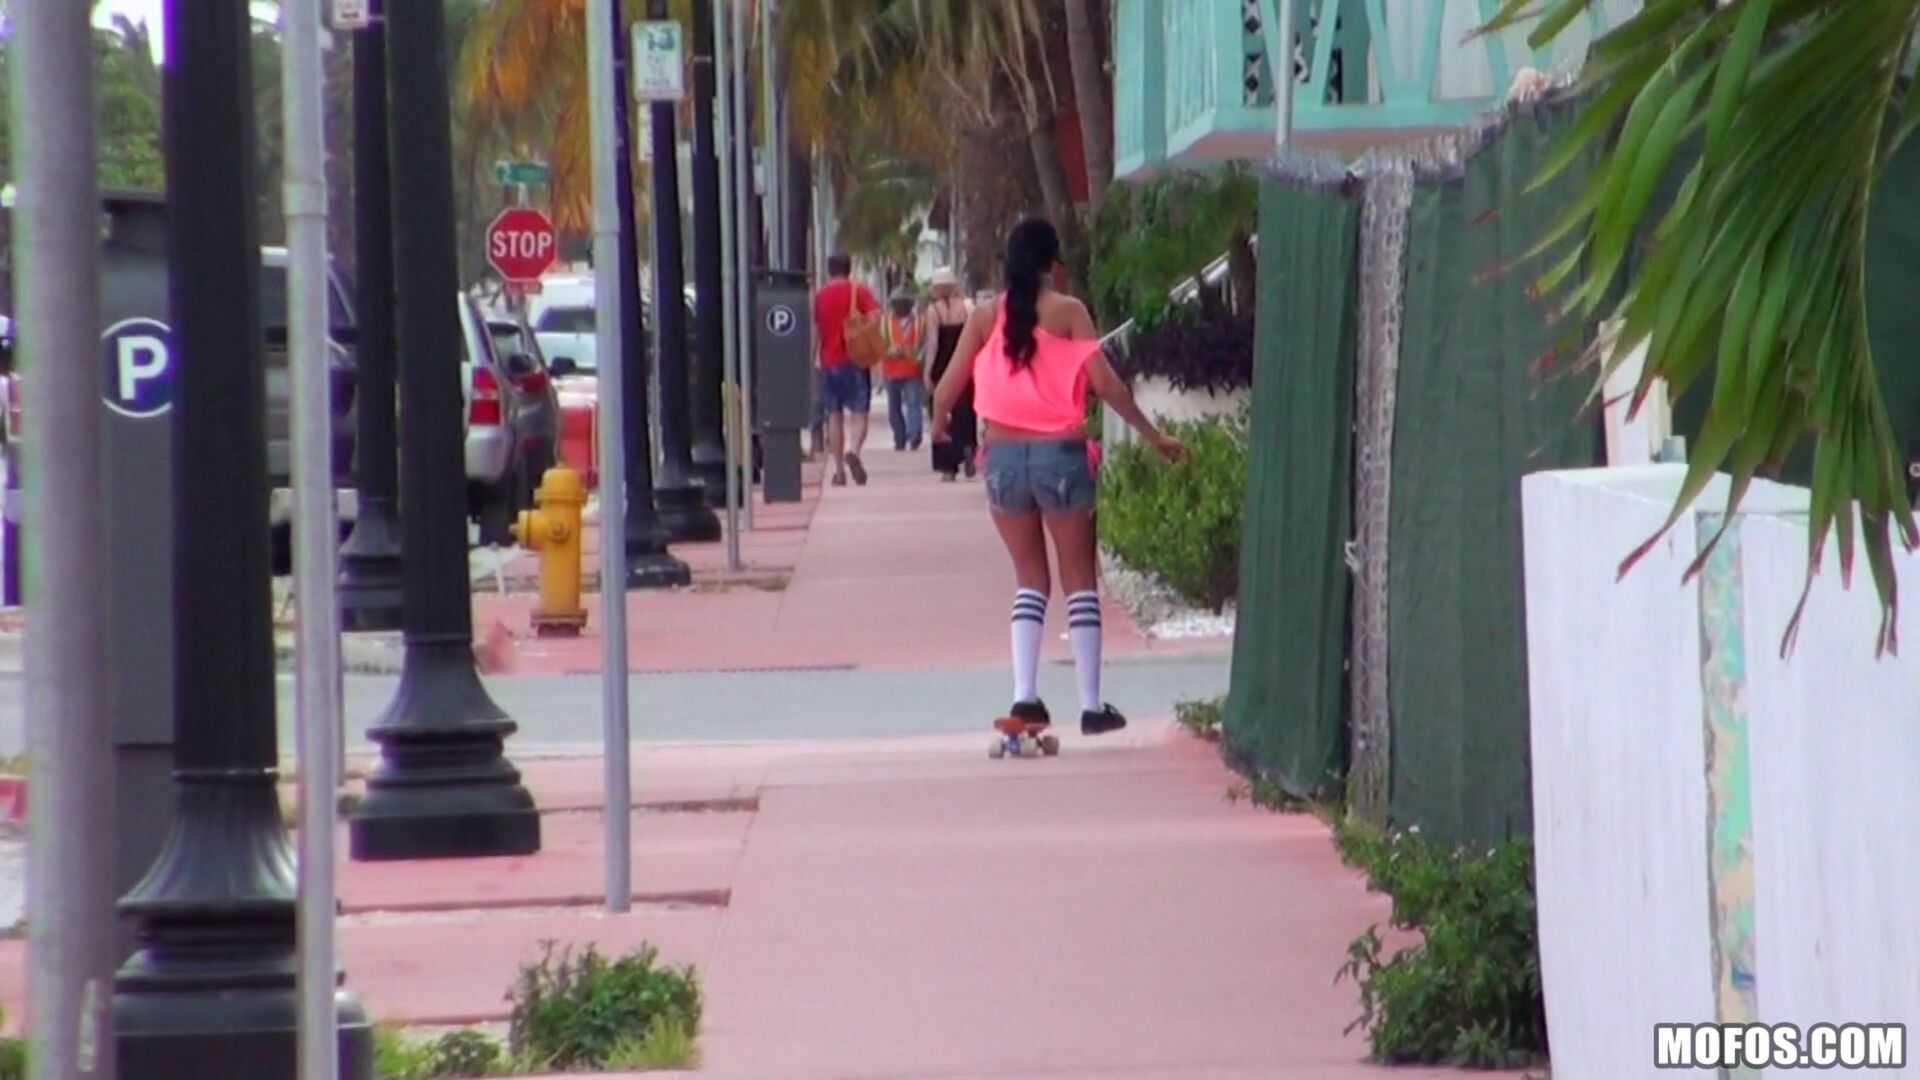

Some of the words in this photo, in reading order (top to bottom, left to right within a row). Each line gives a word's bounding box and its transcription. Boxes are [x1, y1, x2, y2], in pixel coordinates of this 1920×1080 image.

[492, 231, 552, 258] STOP
[774, 310, 790, 330] P
[117, 335, 169, 400] P
